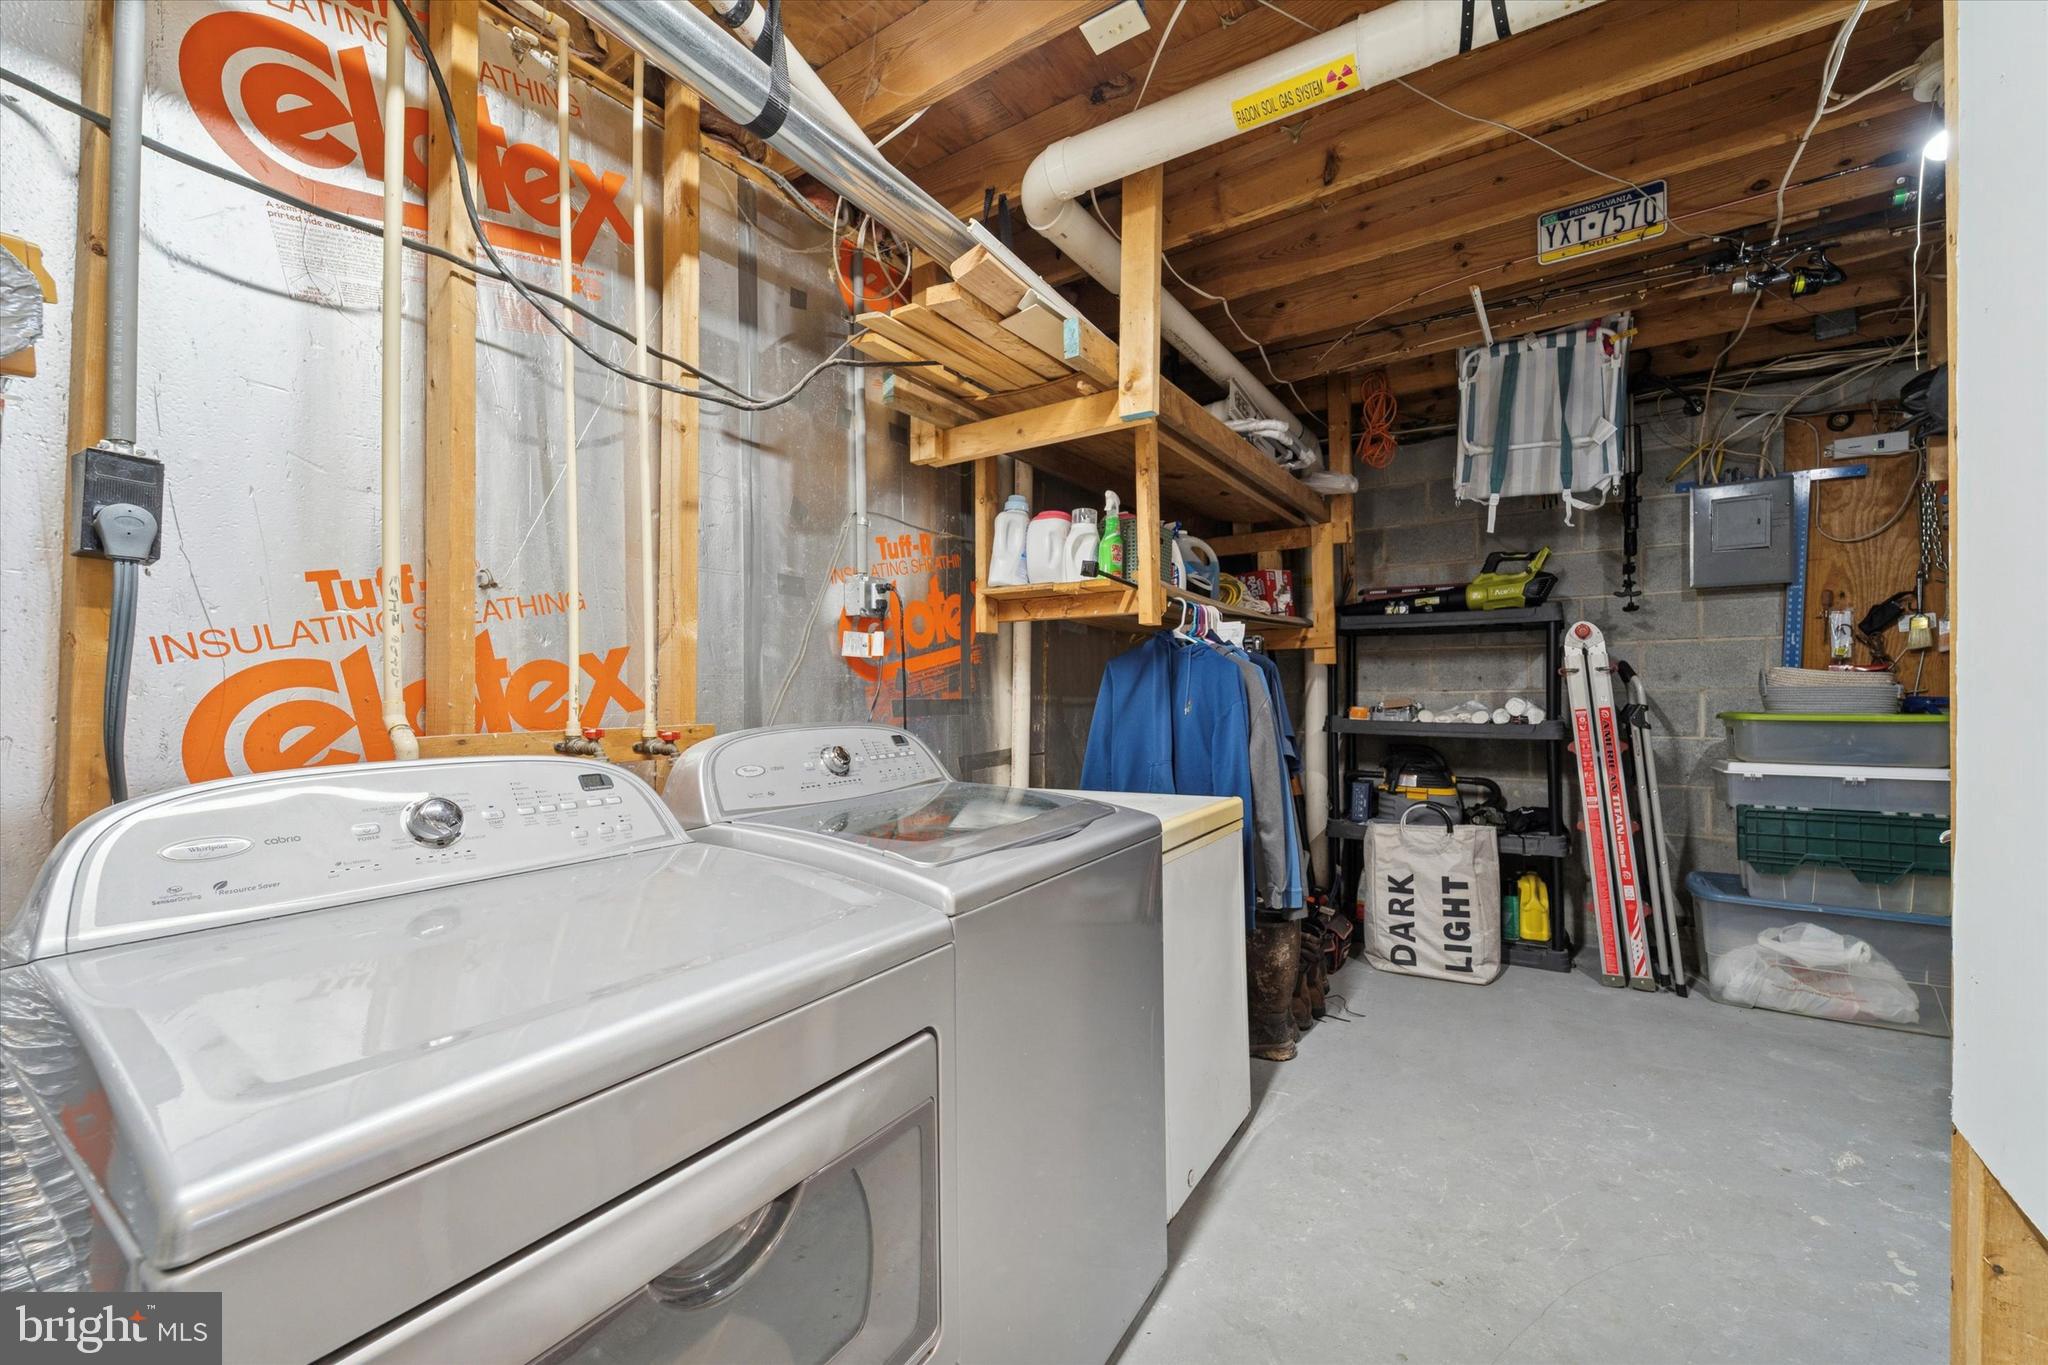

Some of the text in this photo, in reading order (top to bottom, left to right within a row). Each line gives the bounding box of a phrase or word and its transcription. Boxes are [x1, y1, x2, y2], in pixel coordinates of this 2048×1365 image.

[1236, 79, 1325, 125] RADON SOIL GAS SYSTEM
[1569, 193, 1633, 217] PENNSYLVANIA
[1580, 235, 1620, 249] TRUCK
[875, 531, 934, 560] Tuff-R
[1611, 794, 1626, 836] TITAN
[188, 842, 229, 854] Whirlpool
[263, 834, 302, 846] cabrio
[218, 881, 281, 896] Resource Saver
[1388, 873, 1417, 967] DARK
[1441, 876, 1474, 973] LIGHT
